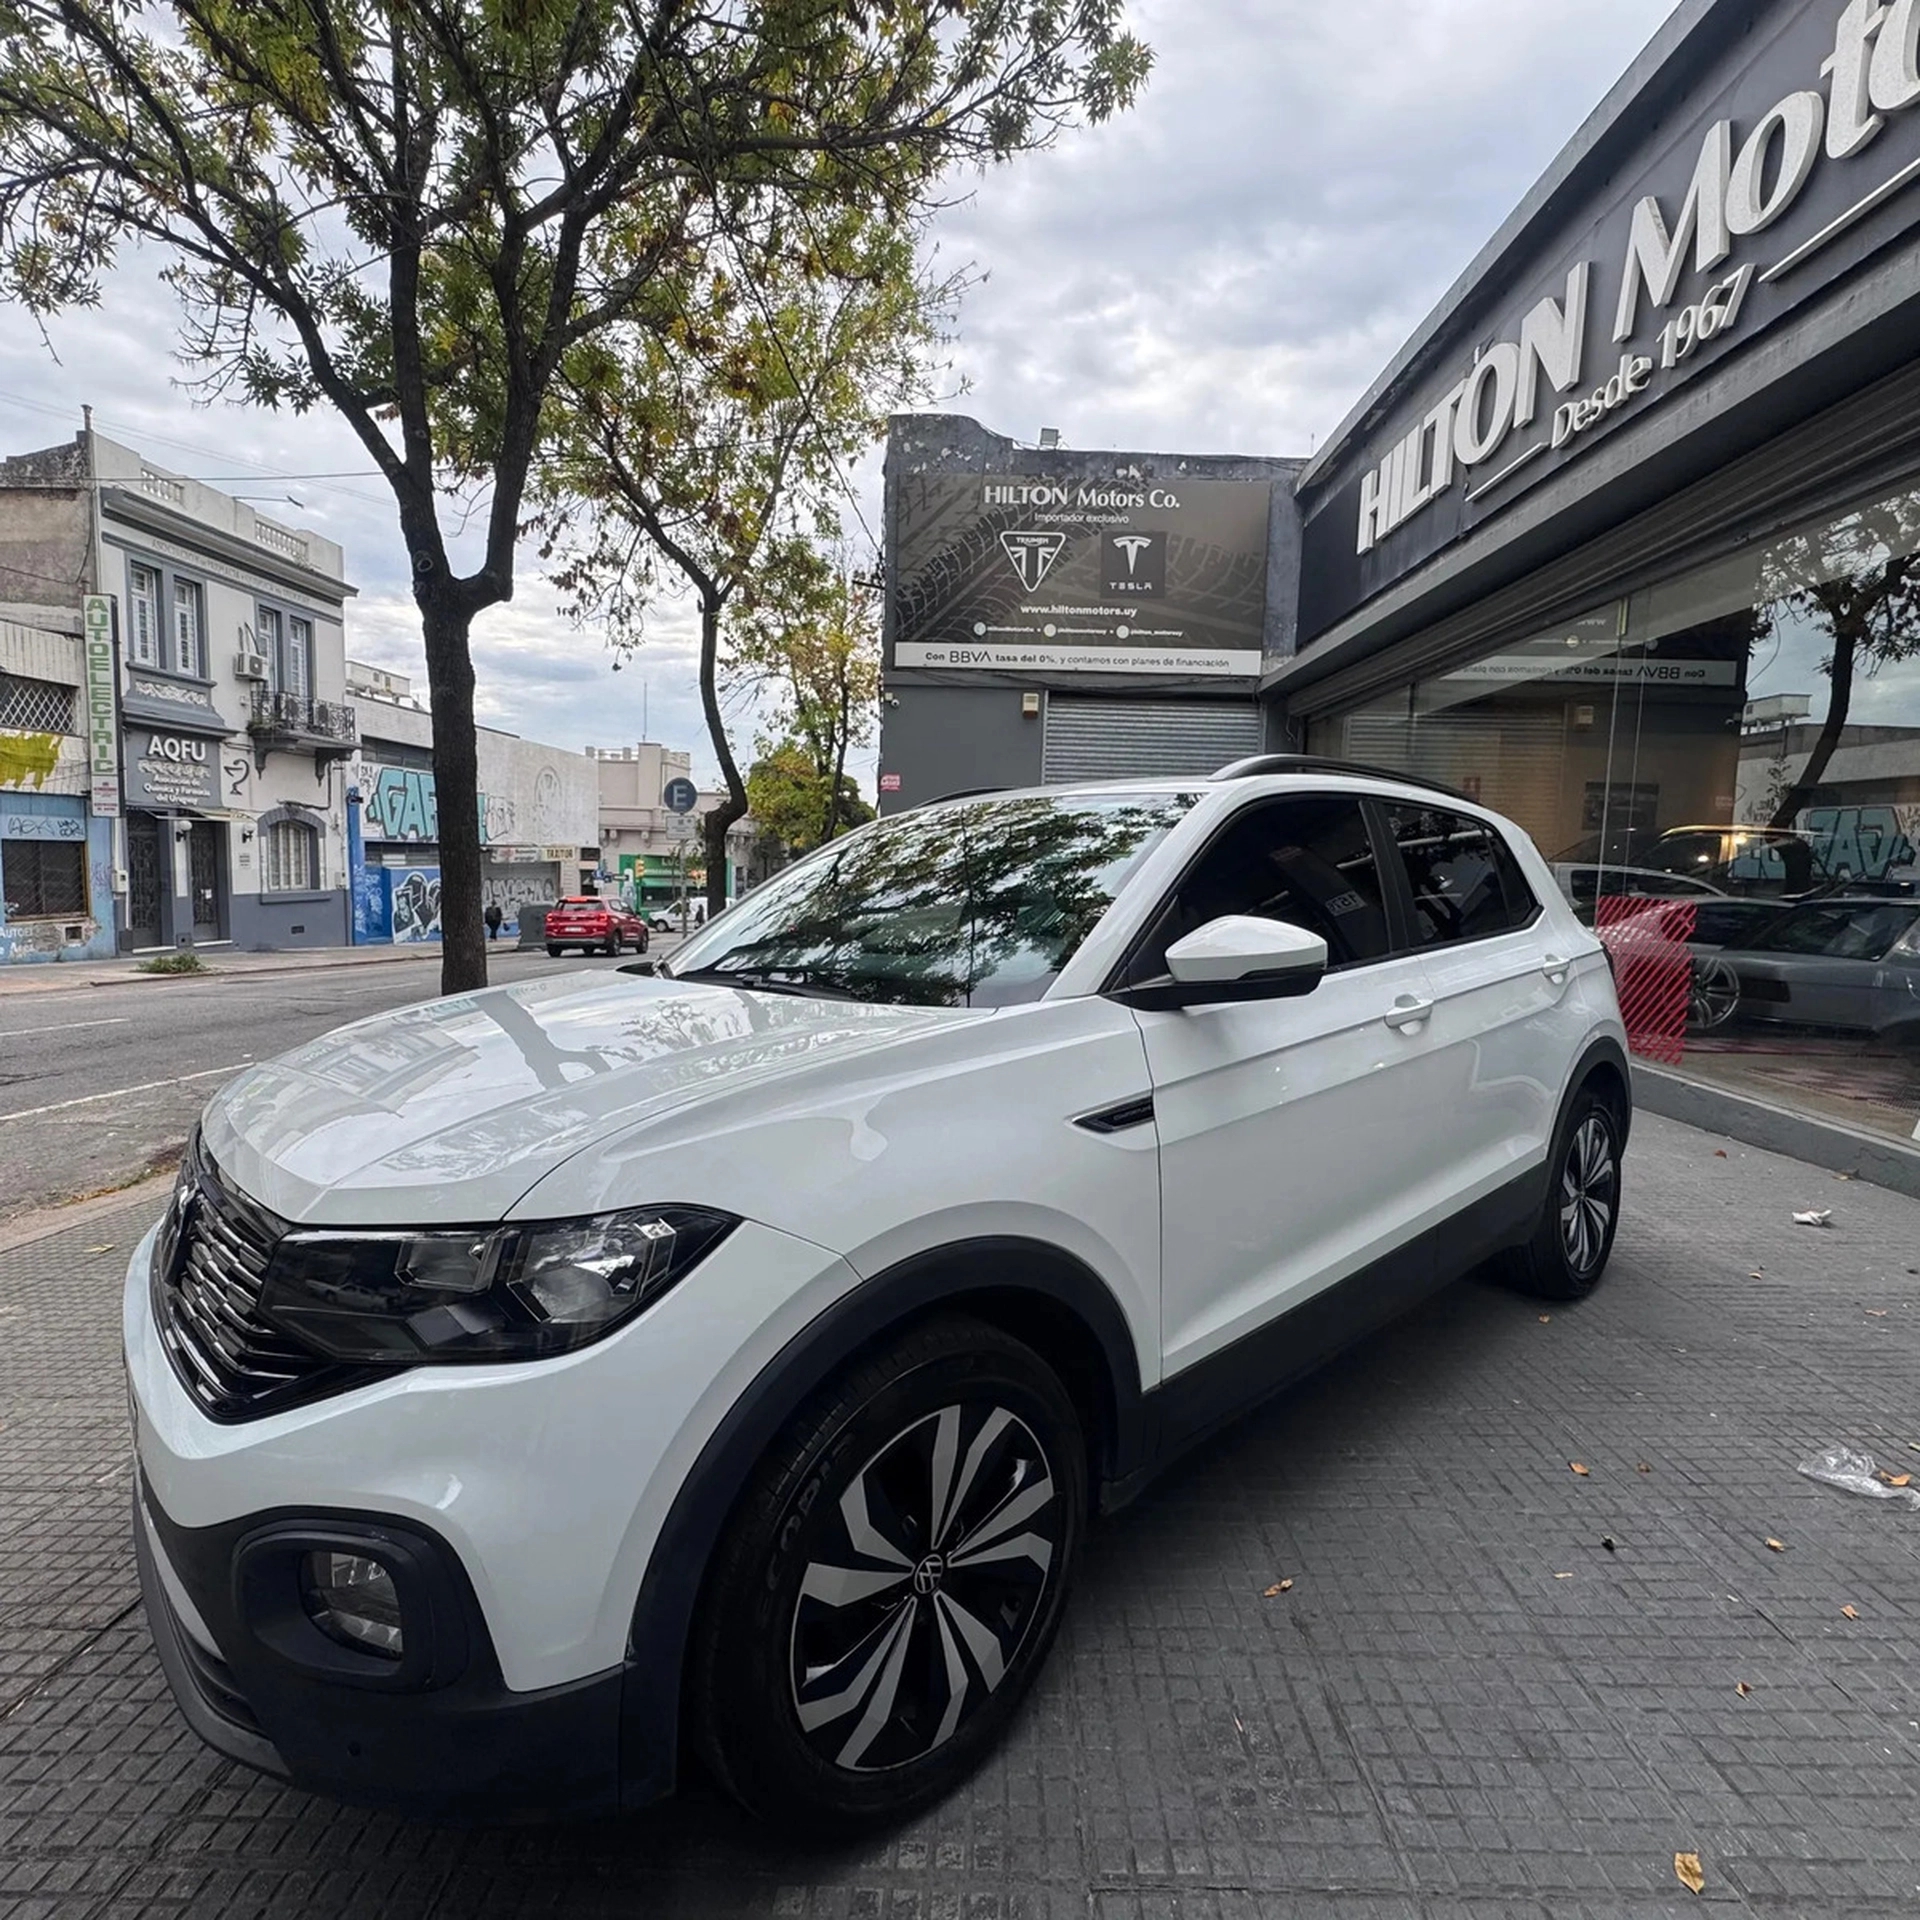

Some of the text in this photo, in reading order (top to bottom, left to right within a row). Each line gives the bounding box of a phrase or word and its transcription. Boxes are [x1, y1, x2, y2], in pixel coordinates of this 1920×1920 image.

[1551, 263, 1757, 449] Desde 1967
[1357, 261, 1591, 555] HILTON
[984, 486, 1180, 508] HILTON Motors Co.
[1034, 512, 1130, 524] Importador exclusivo
[1109, 582, 1152, 590] TESLA
[1020, 605, 1138, 618] www.hiltonmotors.uy
[925, 652, 945, 661] Con
[950, 650, 992, 663] BBVA
[995, 654, 1018, 662] tasa
[1020, 654, 1036, 663] del
[1060, 657, 1066, 665] y
[1067, 657, 1111, 665] contamos
[1131, 656, 1161, 667] planes
[1163, 657, 1175, 666] de
[1175, 657, 1230, 668] financiación
[86, 598, 115, 773] AUTOELECTRIC
[148, 735, 206, 762] AQFU
[673, 785, 687, 806] E
